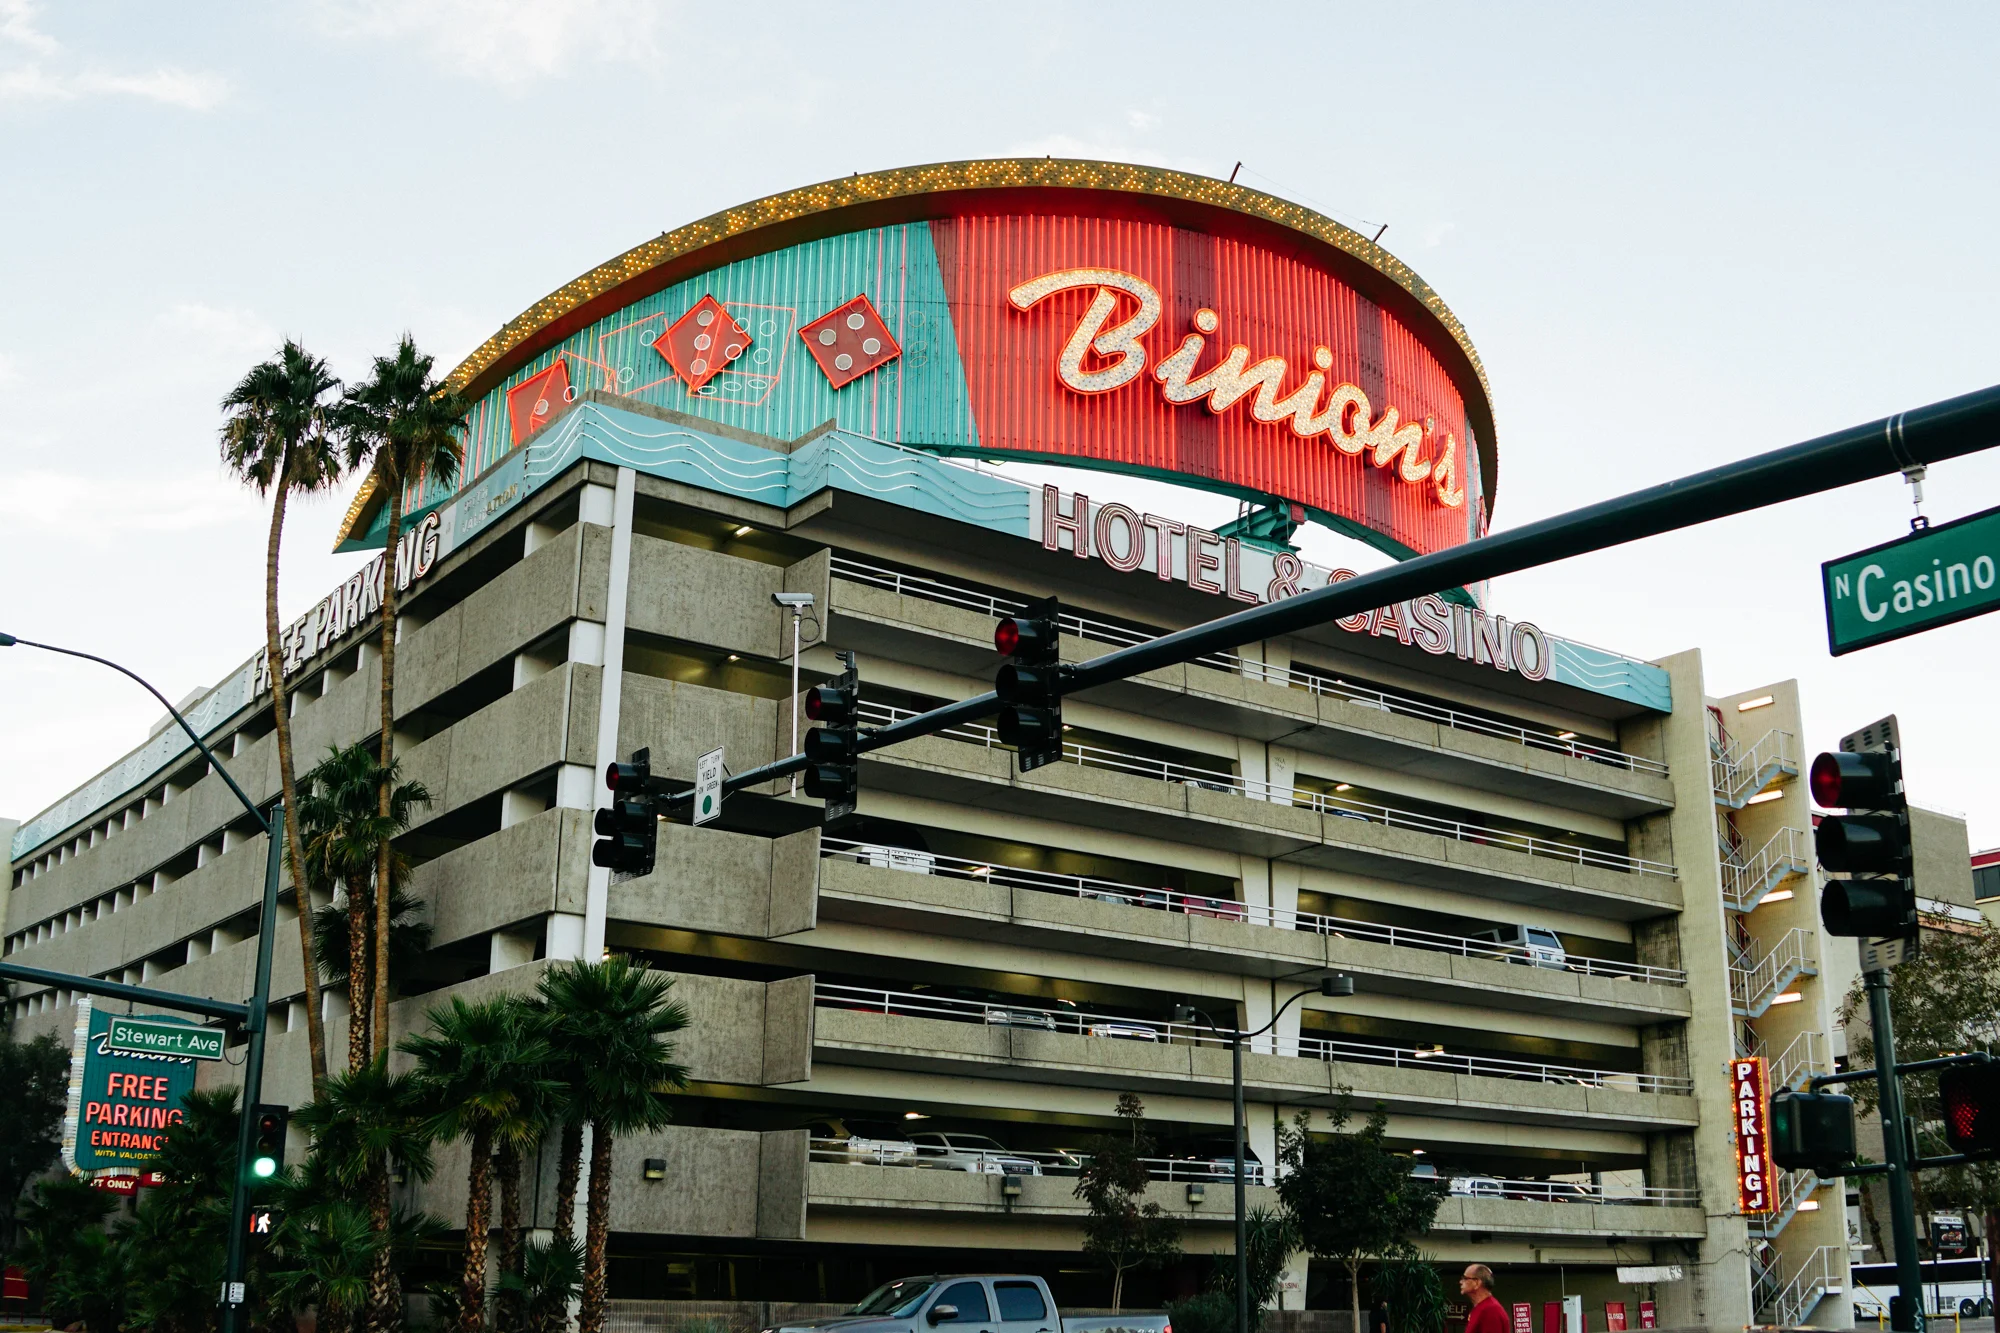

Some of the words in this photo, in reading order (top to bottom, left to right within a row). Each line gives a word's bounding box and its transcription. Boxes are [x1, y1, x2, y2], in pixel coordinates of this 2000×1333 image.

[1008, 266, 1464, 508] Binion's
[1042, 483, 1259, 604] HOTEL
[1267, 551, 1308, 602] &
[311, 510, 440, 657] PARKNG
[1835, 573, 1850, 599] N
[1857, 555, 1996, 622] Casino
[700, 759, 708, 769] LEFT
[702, 767, 717, 782] YIELD
[115, 1027, 183, 1048] Stewart
[187, 1035, 219, 1051] Ave
[107, 1072, 169, 1102] FREE
[1737, 1062, 1762, 1191] PARKING
[90, 1130, 169, 1151] ENTRANC
[94, 1149, 116, 1157] WITH
[106, 1180, 134, 1189] ONLY
[1443, 1304, 1468, 1314] SELF
